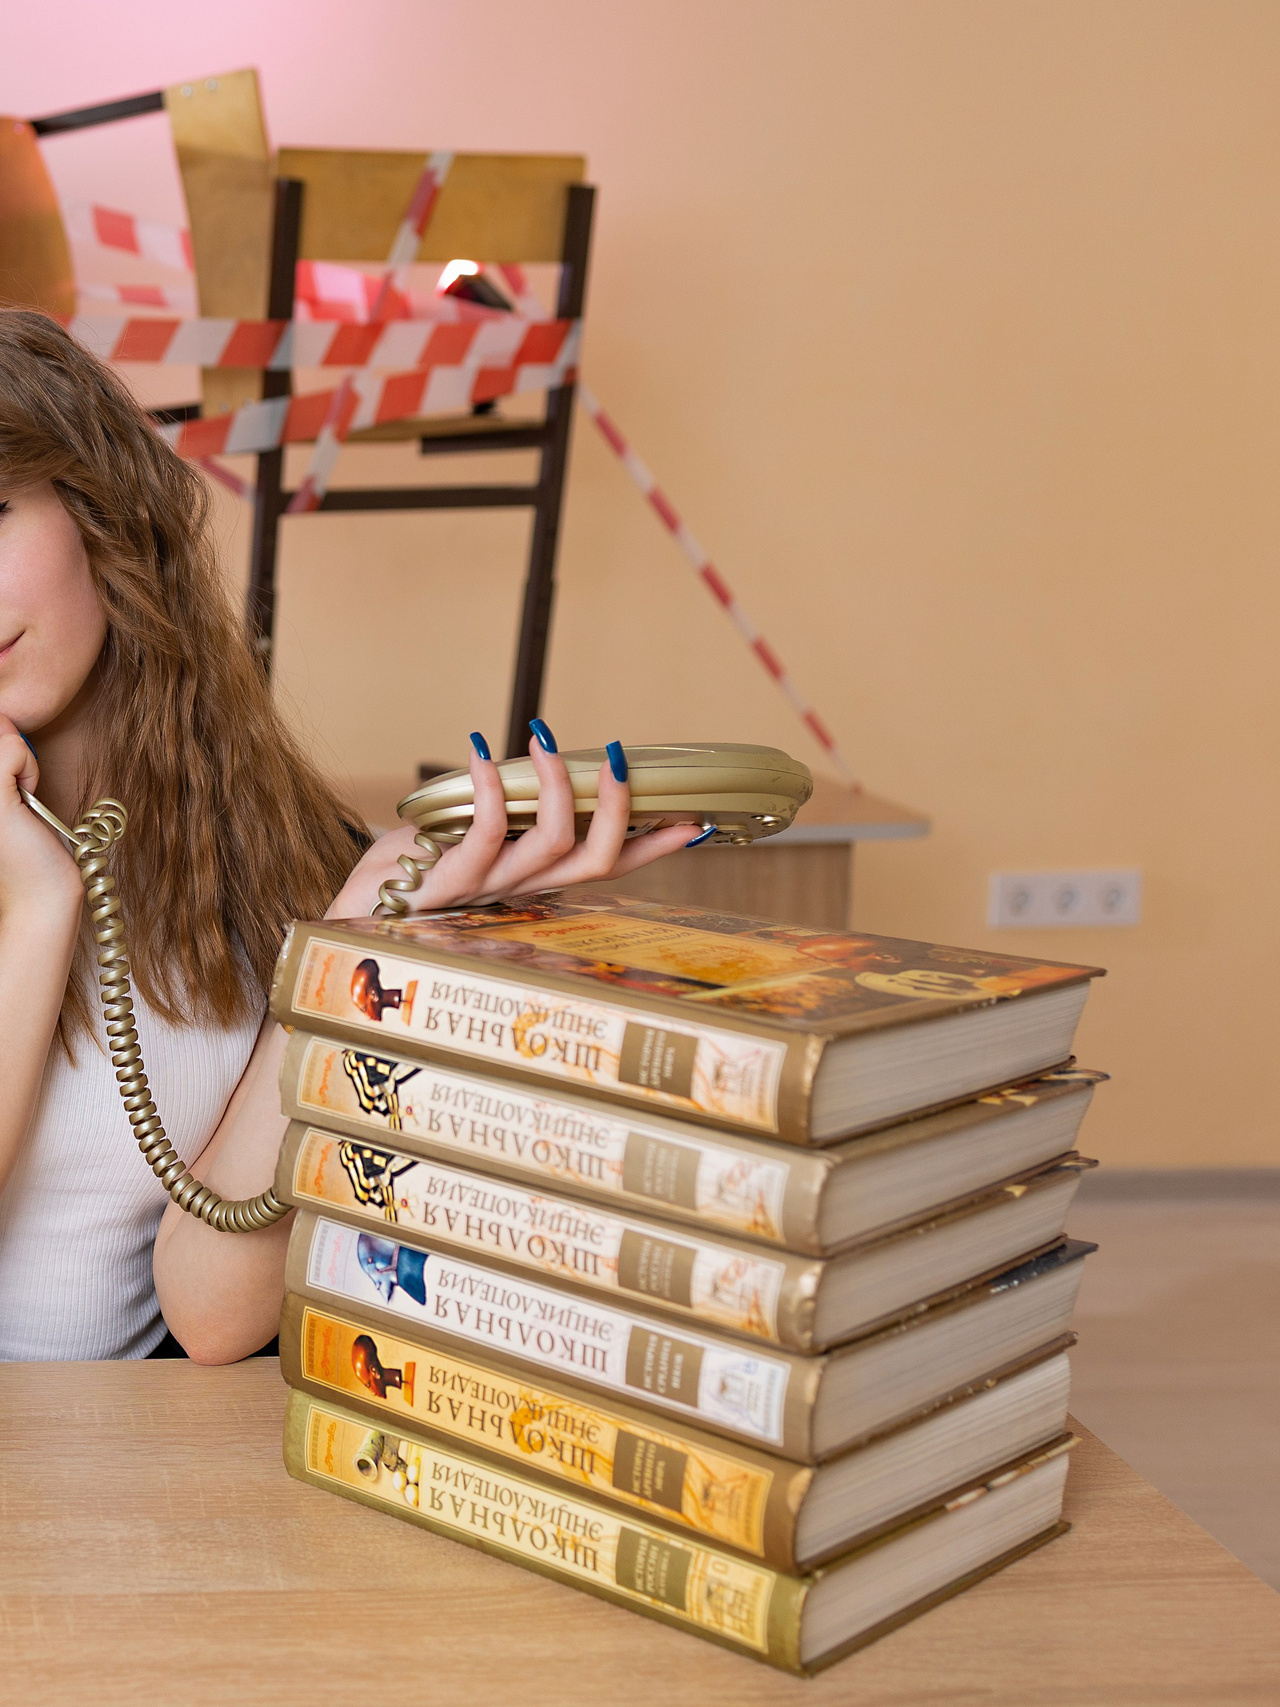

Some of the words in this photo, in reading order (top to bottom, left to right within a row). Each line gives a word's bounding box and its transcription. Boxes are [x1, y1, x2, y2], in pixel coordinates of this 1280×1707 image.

[425, 1007, 602, 1071] ШКОЛЬНАЯ
[430, 982, 608, 1039] ЭНЦИКЛОПЕДИЯ
[427, 1109, 604, 1180] ШКОЛЬНАЯ
[430, 1083, 609, 1149] ЭНЦИКЛОПЕДИЯ
[423, 1202, 599, 1275] ШКОЛЬНАЯ
[426, 1176, 604, 1245] ЭНЦИКЛОПЕДИЯ
[434, 1295, 608, 1372] ШКОЛЬНАЯ
[438, 1270, 613, 1342] ЭНЦИКЛОПЕДИЯ
[643, 1334, 658, 1389] ИСТОРИЯ
[427, 1390, 597, 1474] ШКОЛЬНАЯ
[429, 1366, 601, 1444] ЭНЦИКЛОПЕДИЯ
[431, 1462, 603, 1542] ЭНЦИКЛОПЕДИЯ
[632, 1440, 646, 1493] ИСТОРИЯ
[429, 1486, 598, 1573] ШКОЛЬНАЯ
[634, 1538, 650, 1591] ИСТОРИЯ
